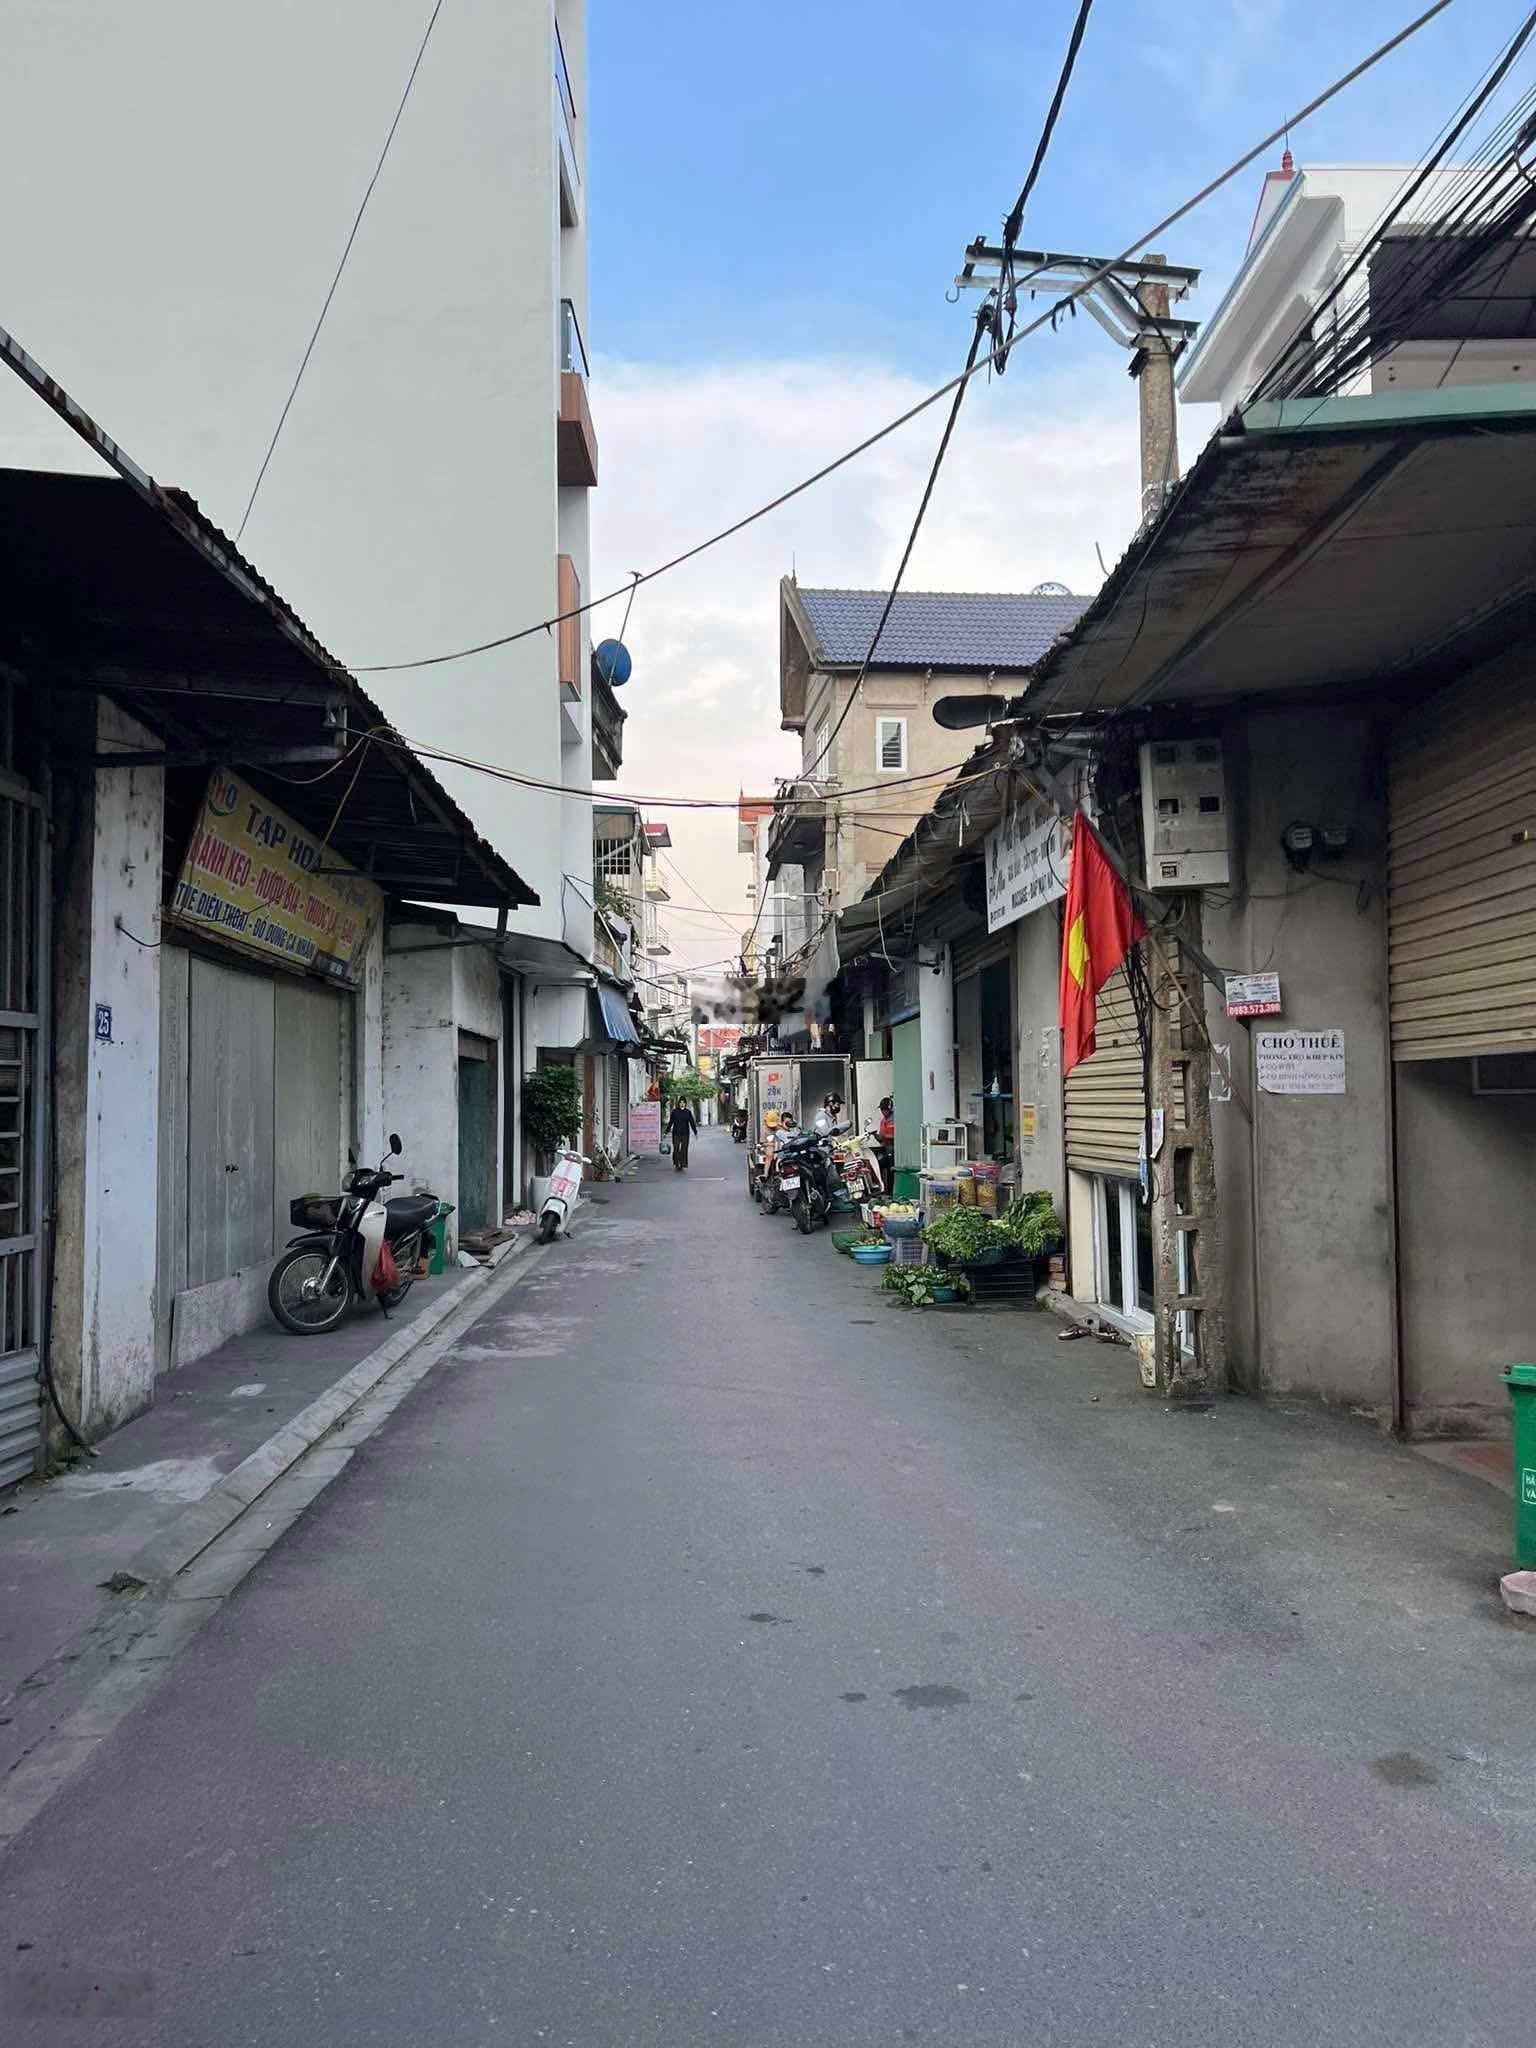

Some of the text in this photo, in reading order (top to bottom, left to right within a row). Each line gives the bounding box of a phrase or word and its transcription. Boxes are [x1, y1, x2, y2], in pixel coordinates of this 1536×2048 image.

[245, 803, 288, 849] TẠP
[187, 827, 227, 876] BÁNH
[226, 846, 252, 891] KẸO
[98, 1010, 109, 1034] 25
[1262, 1034, 1341, 1049] CHO THUÊ
